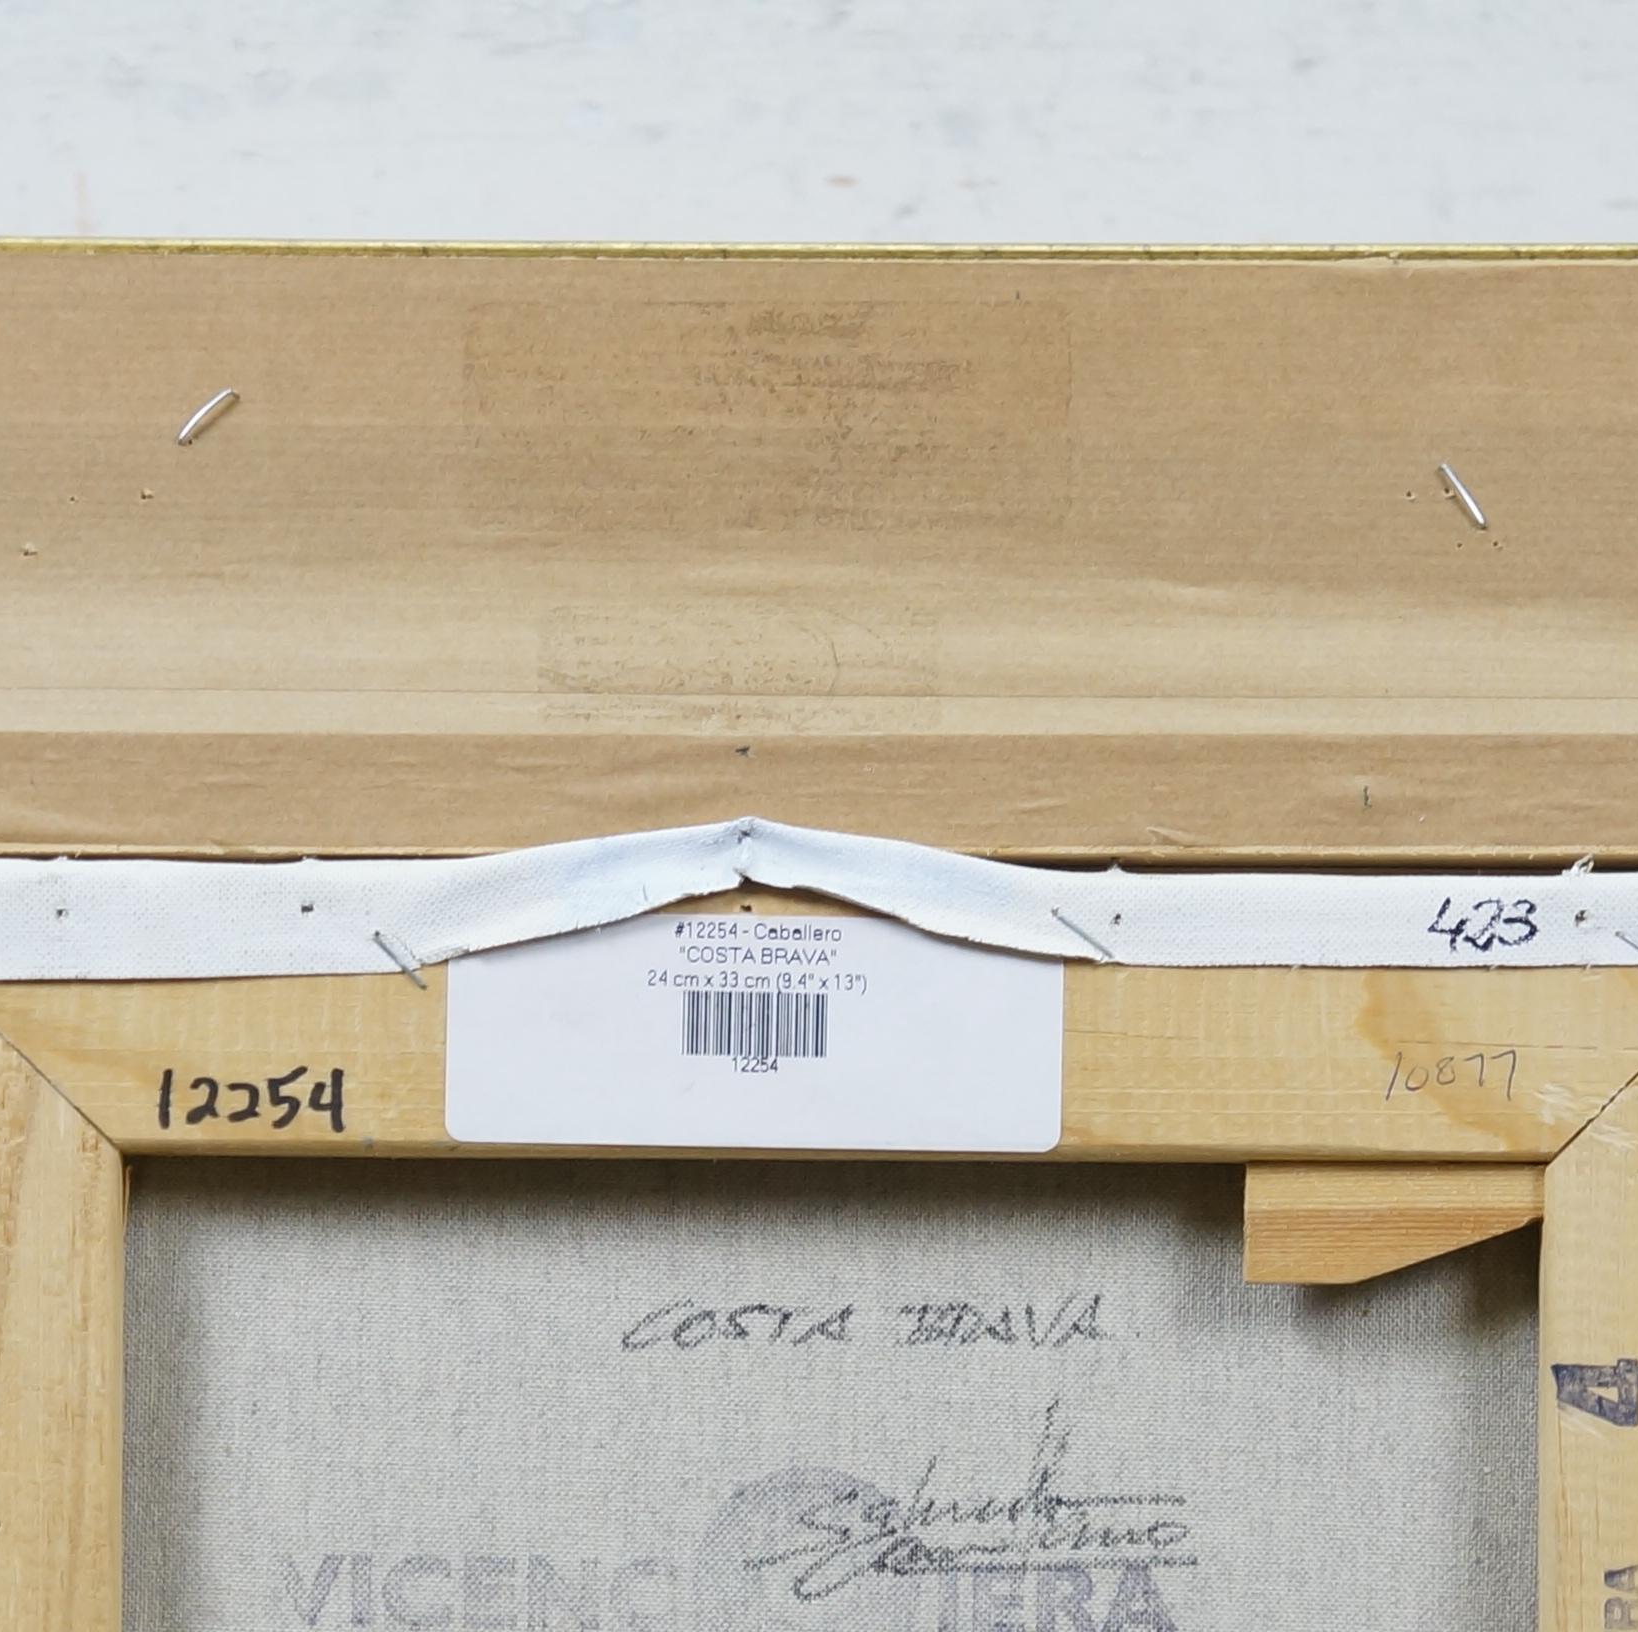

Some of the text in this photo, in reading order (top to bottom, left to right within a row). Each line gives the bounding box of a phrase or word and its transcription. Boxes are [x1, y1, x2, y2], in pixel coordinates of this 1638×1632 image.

[674, 921, 738, 940] #12254
[753, 922, 842, 942] Caballero
[1427, 896, 1540, 953] 423
[679, 945, 837, 966] "COSTA BRAVA"
[647, 969, 668, 987] 24
[673, 973, 699, 988] cm
[704, 977, 714, 987] x
[719, 970, 739, 988] 33
[744, 974, 770, 989] cm
[819, 978, 829, 989] x
[731, 1056, 779, 1073] 12254
[157, 1065, 346, 1133] 12254
[621, 1299, 854, 1352] COSTA
